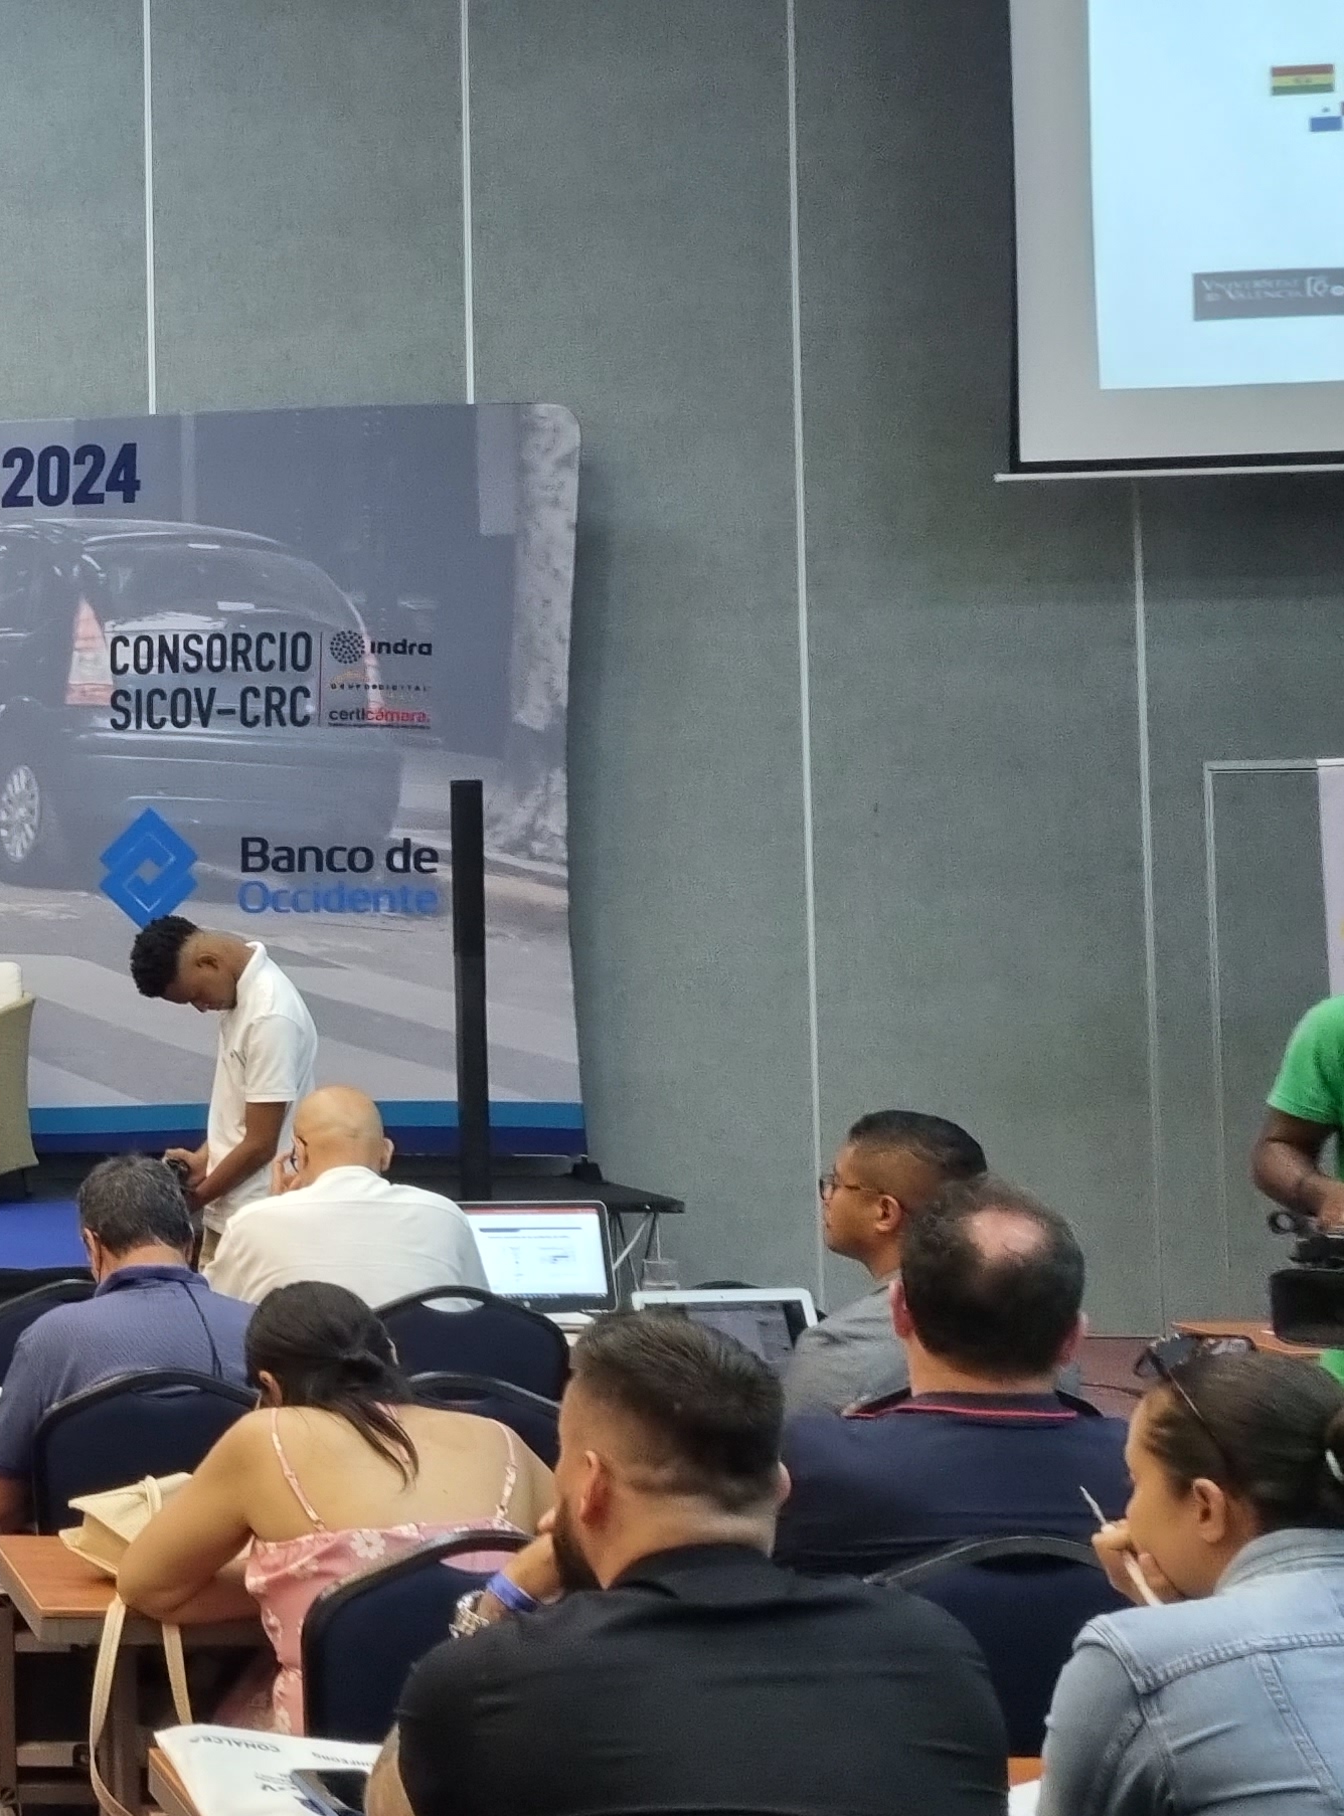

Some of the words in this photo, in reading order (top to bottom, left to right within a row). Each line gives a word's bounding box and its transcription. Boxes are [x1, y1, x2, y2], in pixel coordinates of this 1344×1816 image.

[1, 443, 141, 508] 2024
[110, 631, 313, 675] CONSORCIO
[110, 686, 311, 731] SICOV-CRC
[241, 837, 374, 873] Banco
[386, 838, 439, 873] de
[238, 880, 439, 914] Occidente
